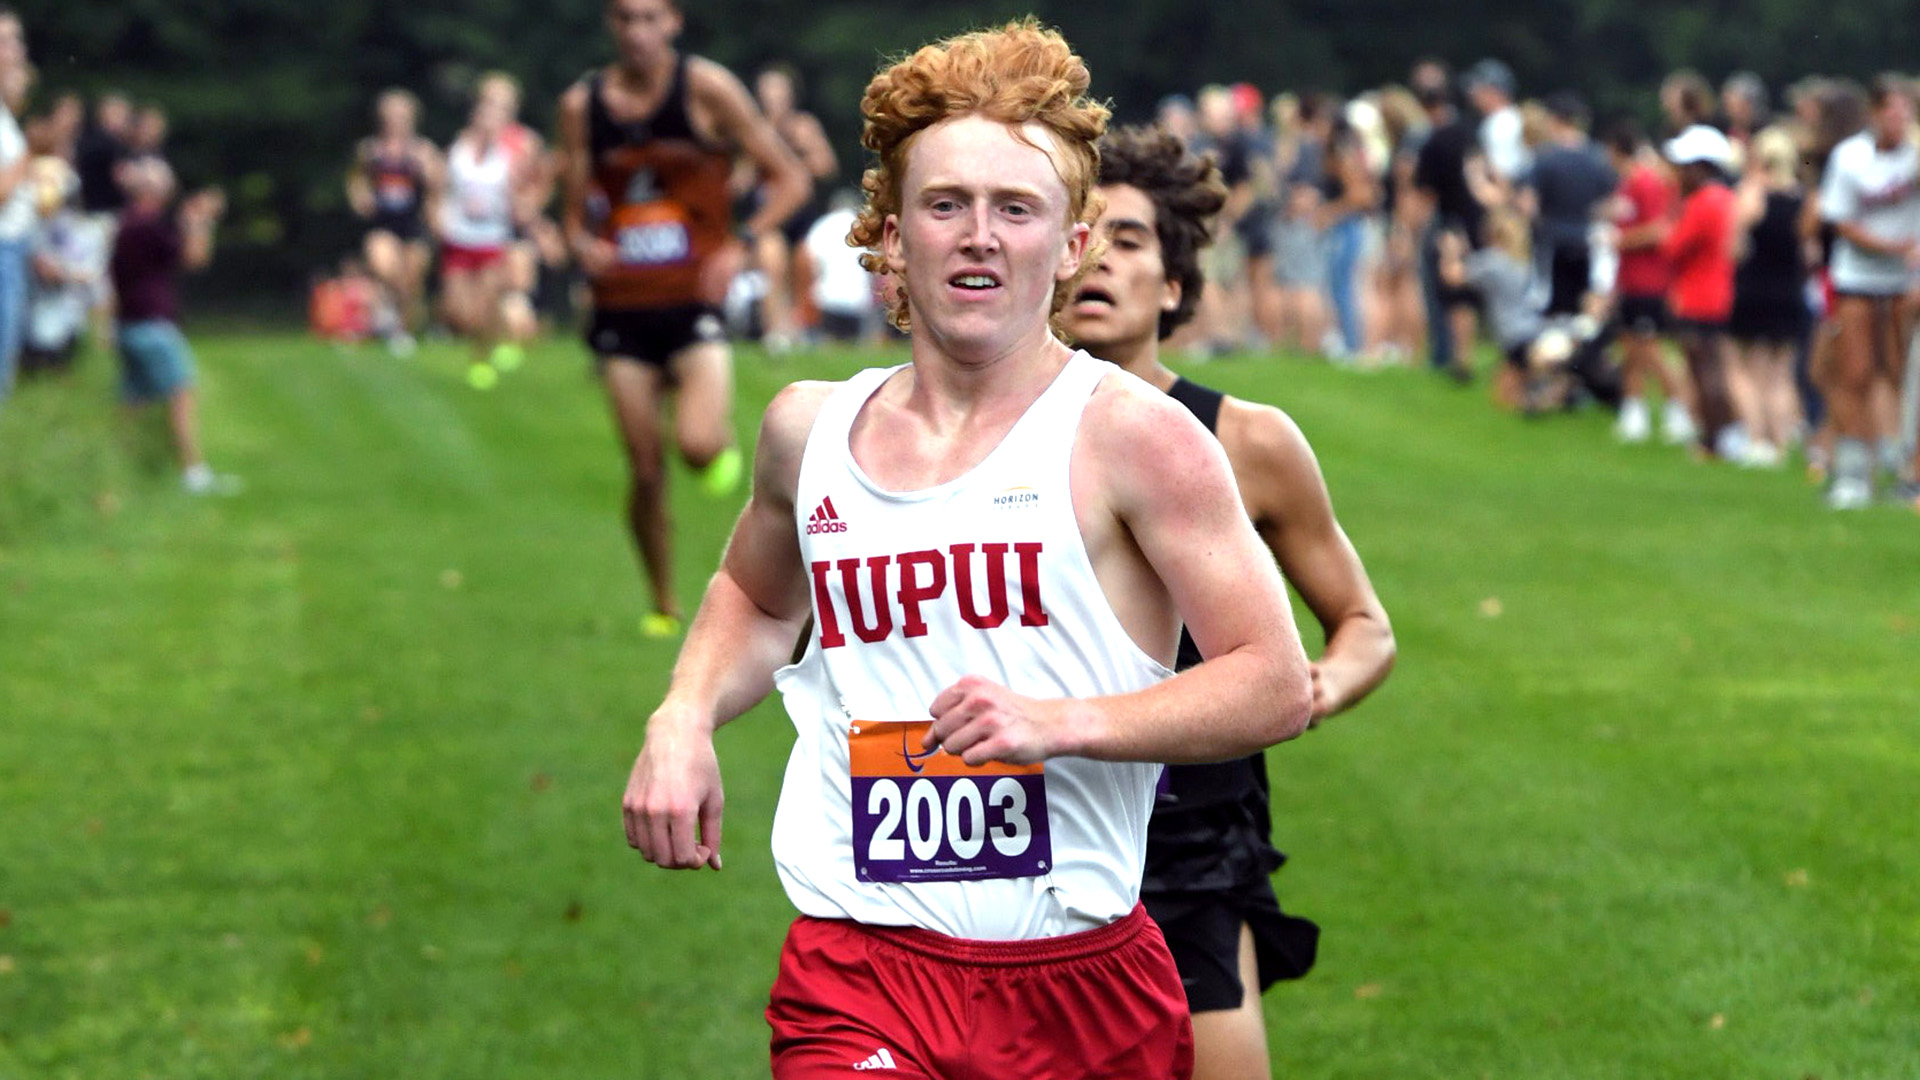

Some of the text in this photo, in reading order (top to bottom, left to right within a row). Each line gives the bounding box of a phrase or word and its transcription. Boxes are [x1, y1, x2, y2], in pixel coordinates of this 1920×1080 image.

[993, 493, 1039, 504] HORIZON
[806, 519, 847, 535] adidas
[811, 542, 1049, 649] IUPUI
[868, 777, 1032, 861] 2003
